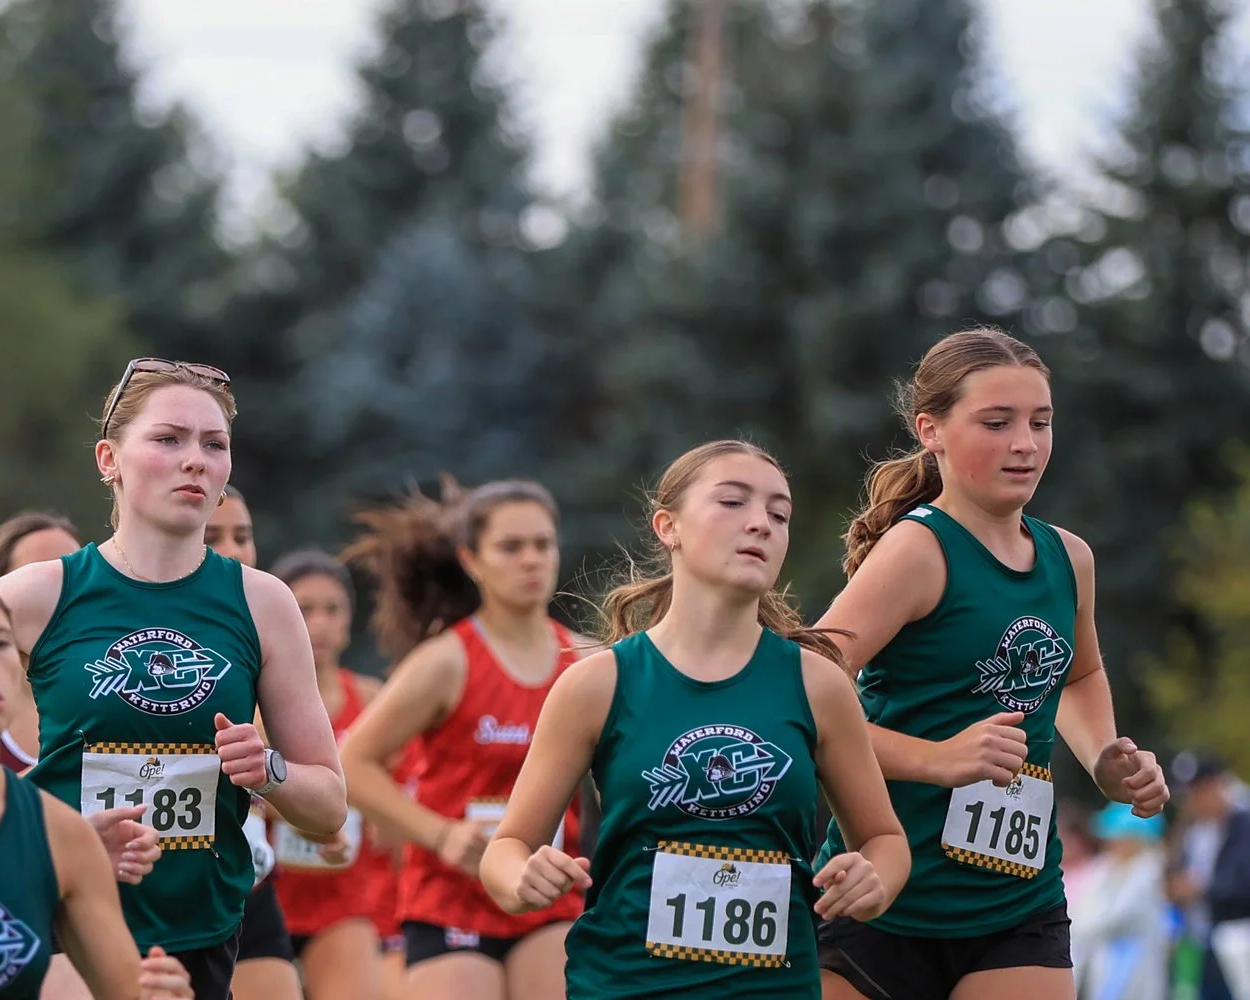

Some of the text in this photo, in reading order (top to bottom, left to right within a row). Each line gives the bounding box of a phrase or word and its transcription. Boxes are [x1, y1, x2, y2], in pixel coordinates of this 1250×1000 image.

[113, 630, 193, 651] WATERFORD
[1002, 618, 1053, 649] WATERFORD
[128, 681, 211, 713] KETTERING
[670, 727, 755, 756] WATERFORD
[140, 764, 165, 779] Ope!
[687, 783, 771, 818] KETTERING
[965, 800, 1042, 860] 1185
[713, 870, 741, 886] Ope!
[666, 893, 778, 947] 1186
